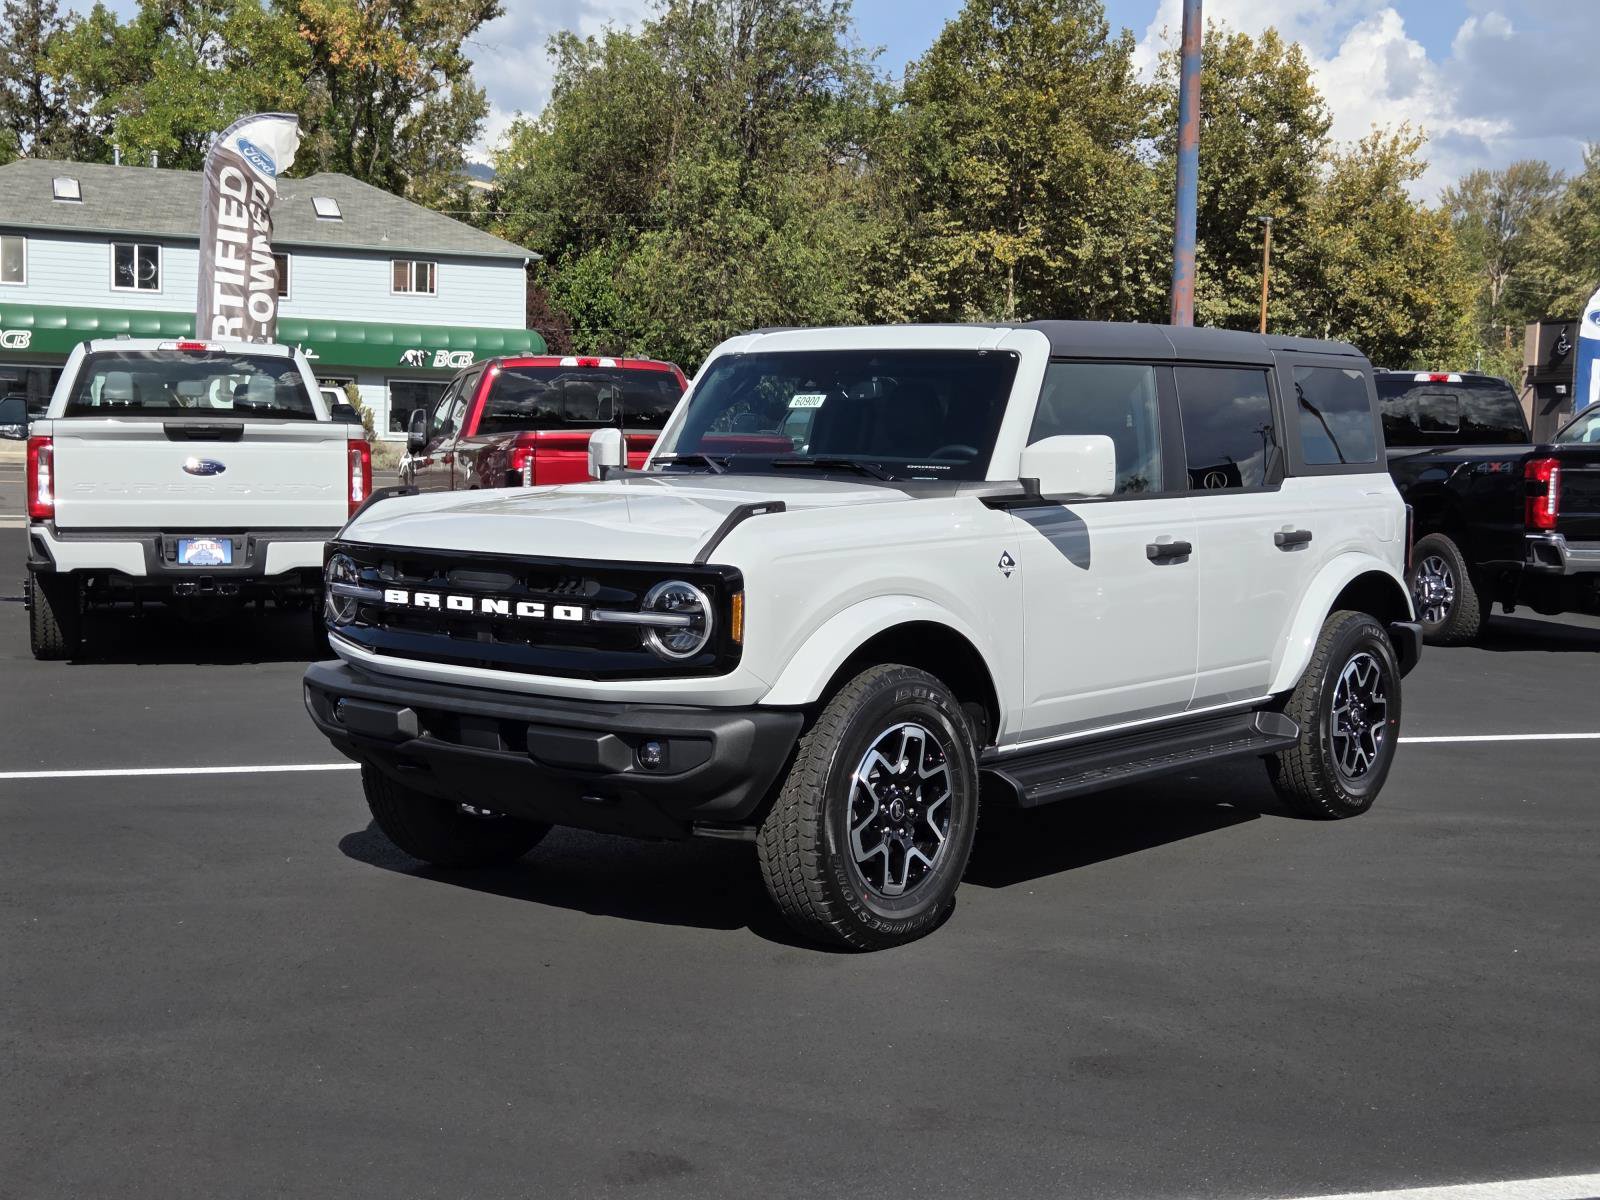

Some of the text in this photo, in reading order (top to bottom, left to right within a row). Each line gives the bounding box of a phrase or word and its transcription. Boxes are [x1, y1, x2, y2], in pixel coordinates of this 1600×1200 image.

[243, 146, 275, 174] Ford
[248, 180, 276, 344] -OWNED
[0, 329, 32, 349] CB
[432, 349, 474, 368] BCB
[794, 396, 820, 406] 60900
[384, 589, 583, 621] BRONCO
